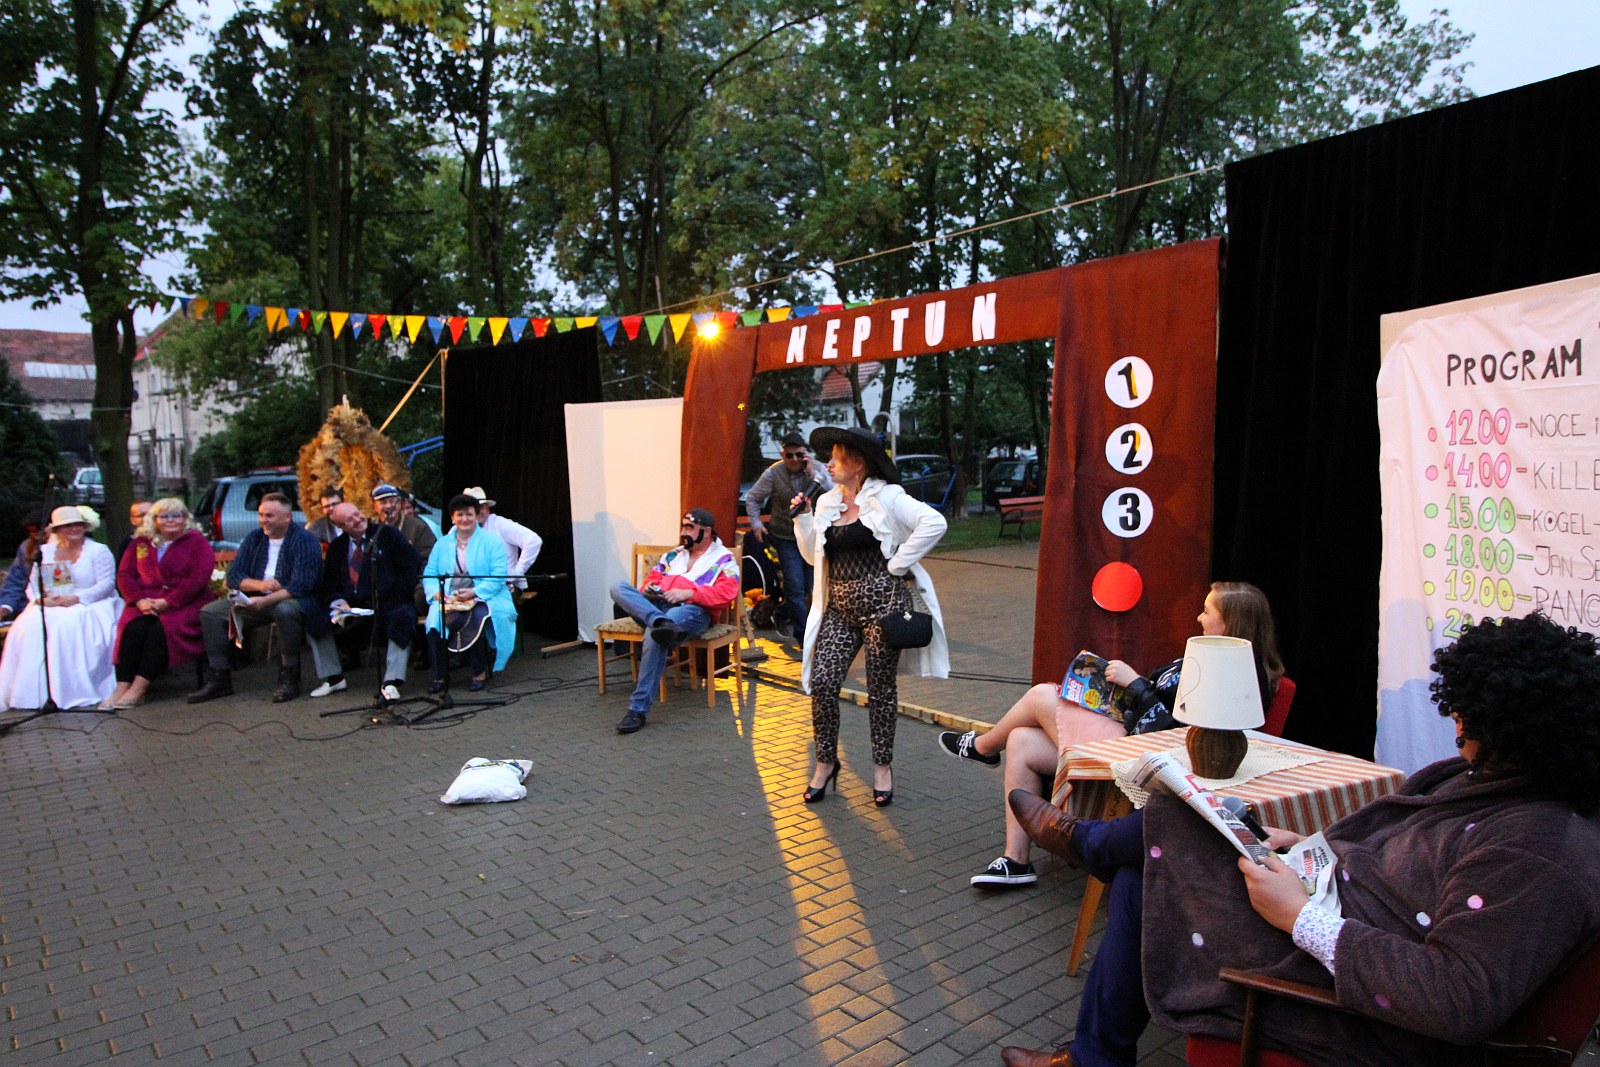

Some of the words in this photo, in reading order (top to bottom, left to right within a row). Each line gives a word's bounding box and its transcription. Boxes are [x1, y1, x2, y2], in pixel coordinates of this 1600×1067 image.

[786, 292, 997, 364] NEPTUN
[1117, 362, 1139, 401] 1
[1446, 338, 1582, 387] PROGRAM
[1445, 407, 1511, 446] 12.00
[1529, 413, 1586, 438] NOCE
[1119, 430, 1143, 470] 2
[1444, 452, 1511, 489] 14.00
[1118, 492, 1141, 532] 3
[1445, 493, 1516, 534] 15.00
[1444, 533, 1514, 575] 18.00
[1445, 569, 1515, 612] 19.00
